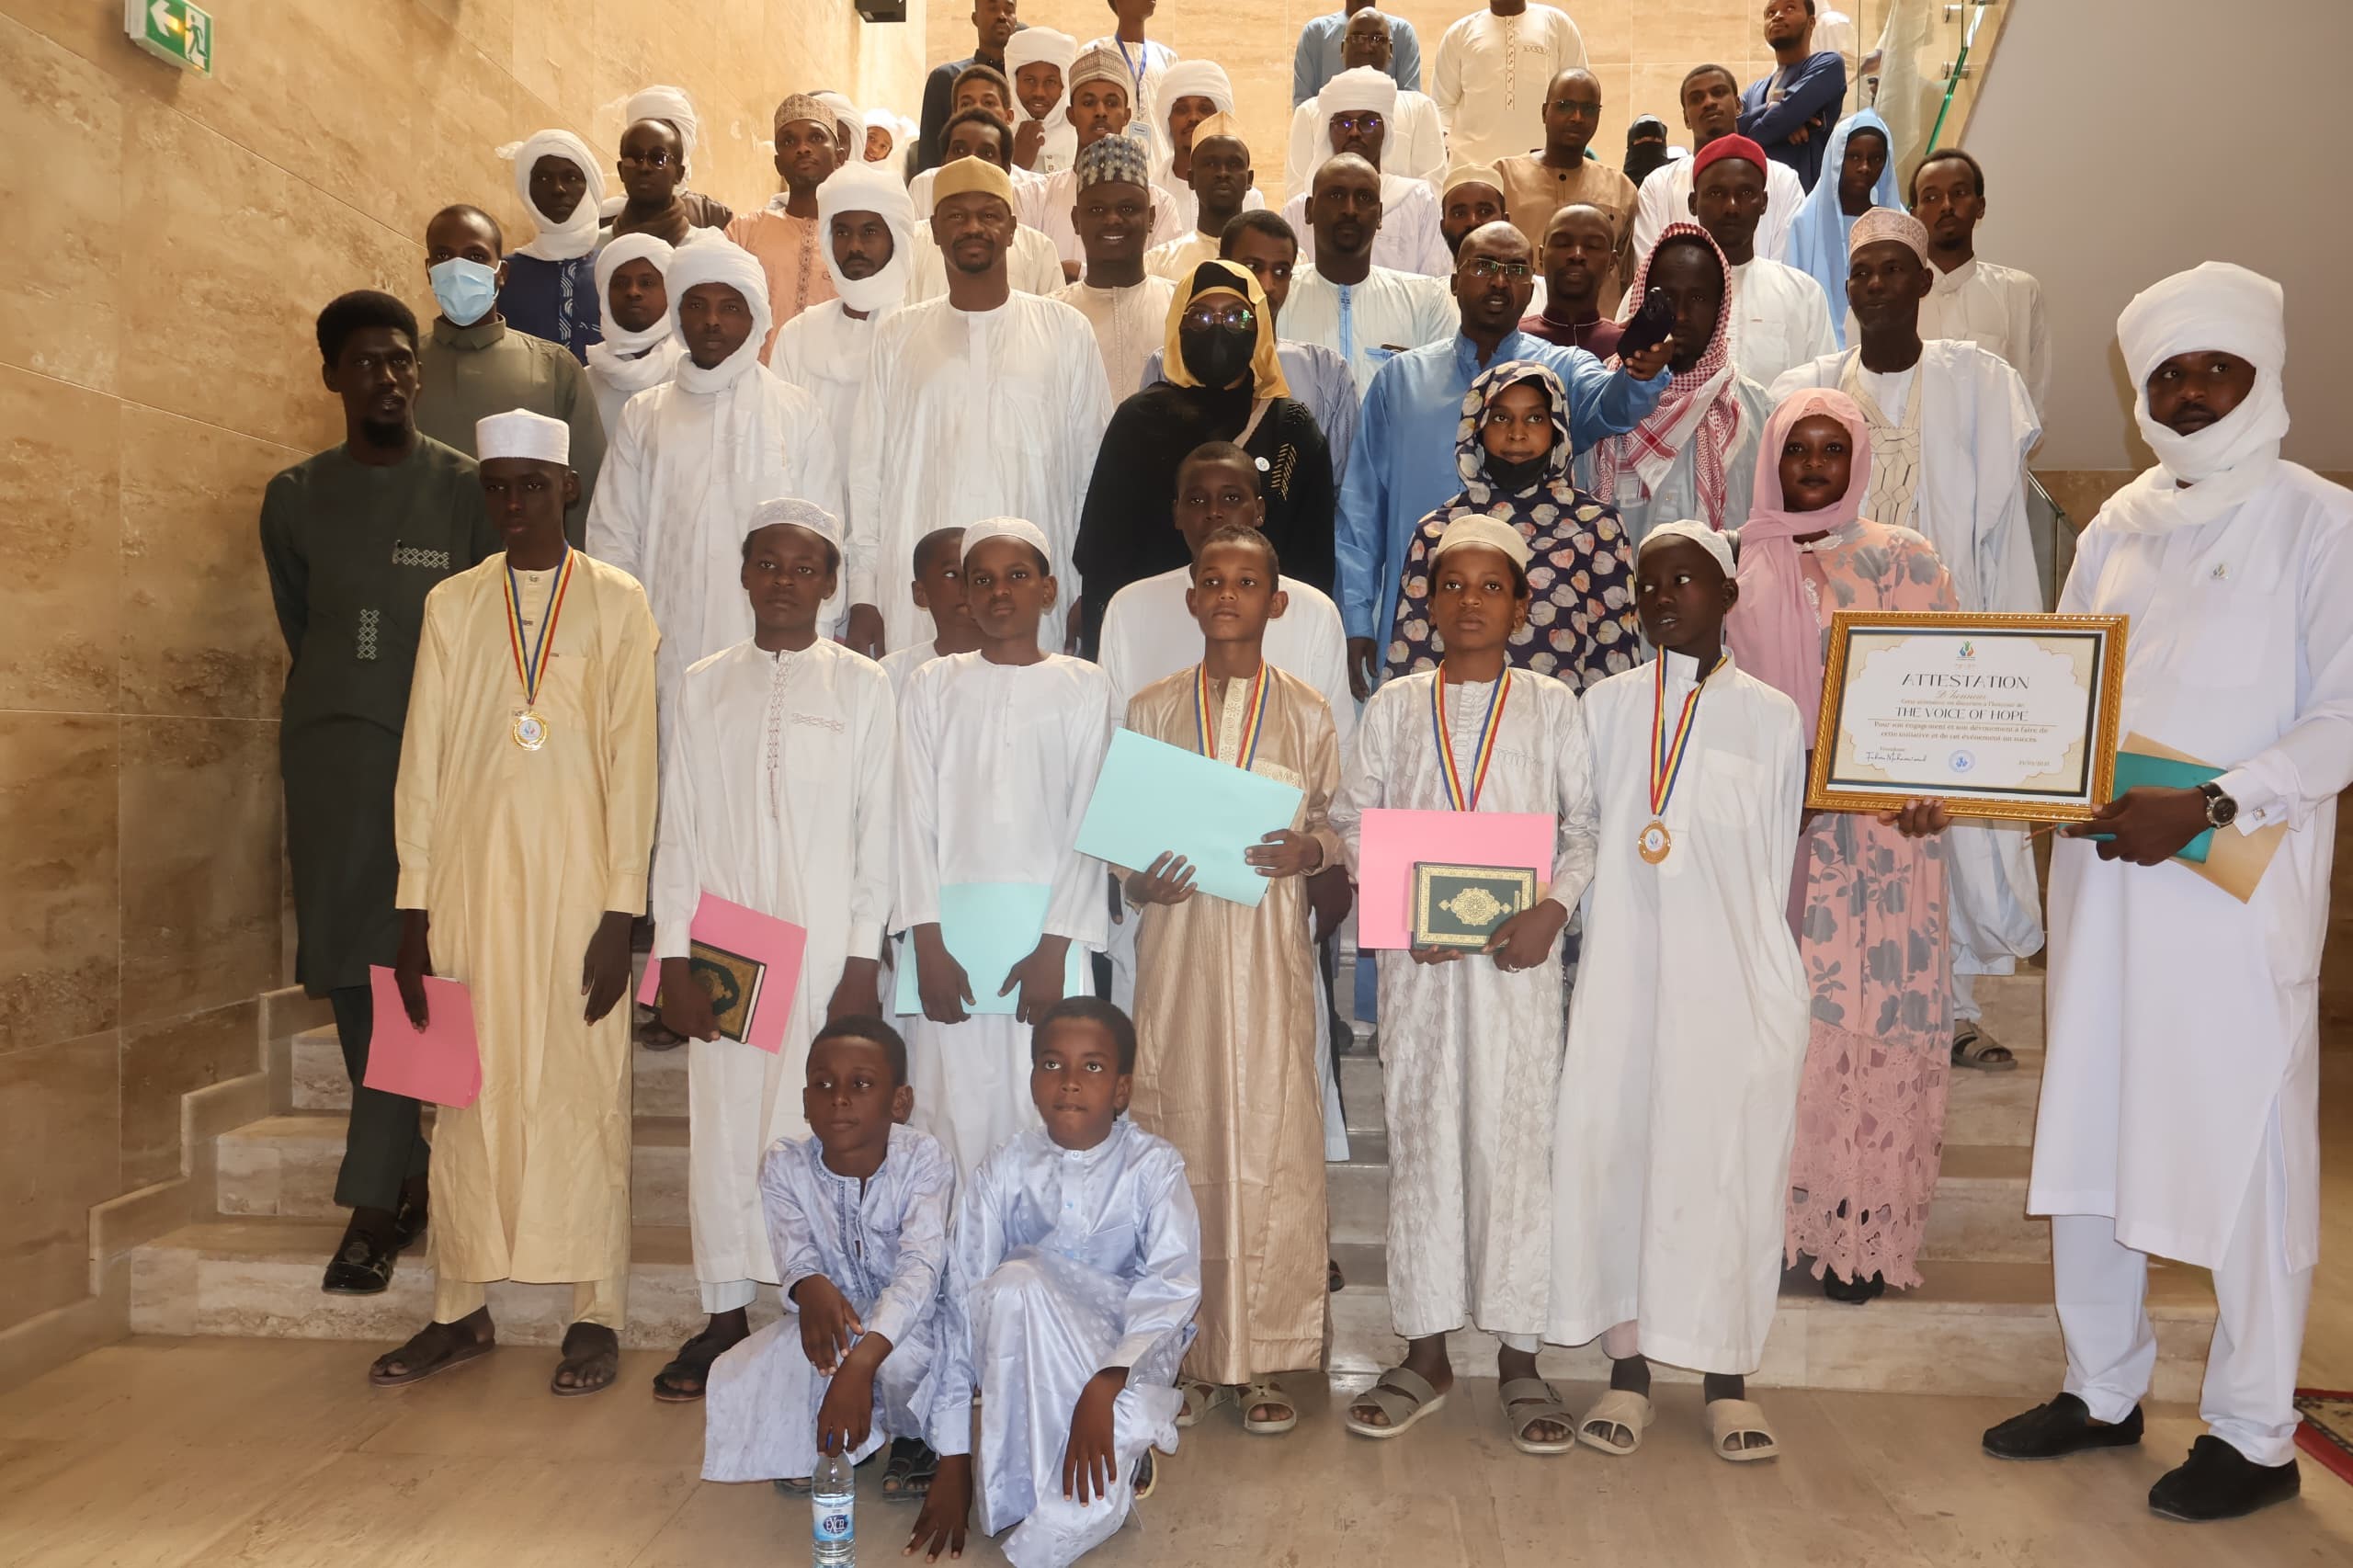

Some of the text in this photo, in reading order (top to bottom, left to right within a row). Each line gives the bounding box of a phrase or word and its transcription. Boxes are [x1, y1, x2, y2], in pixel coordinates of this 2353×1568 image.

[1902, 674, 2029, 689] ATTESTATION
[1895, 707, 2029, 722] THE VOICE OF HOPE
[1904, 722, 1945, 731] engagement
